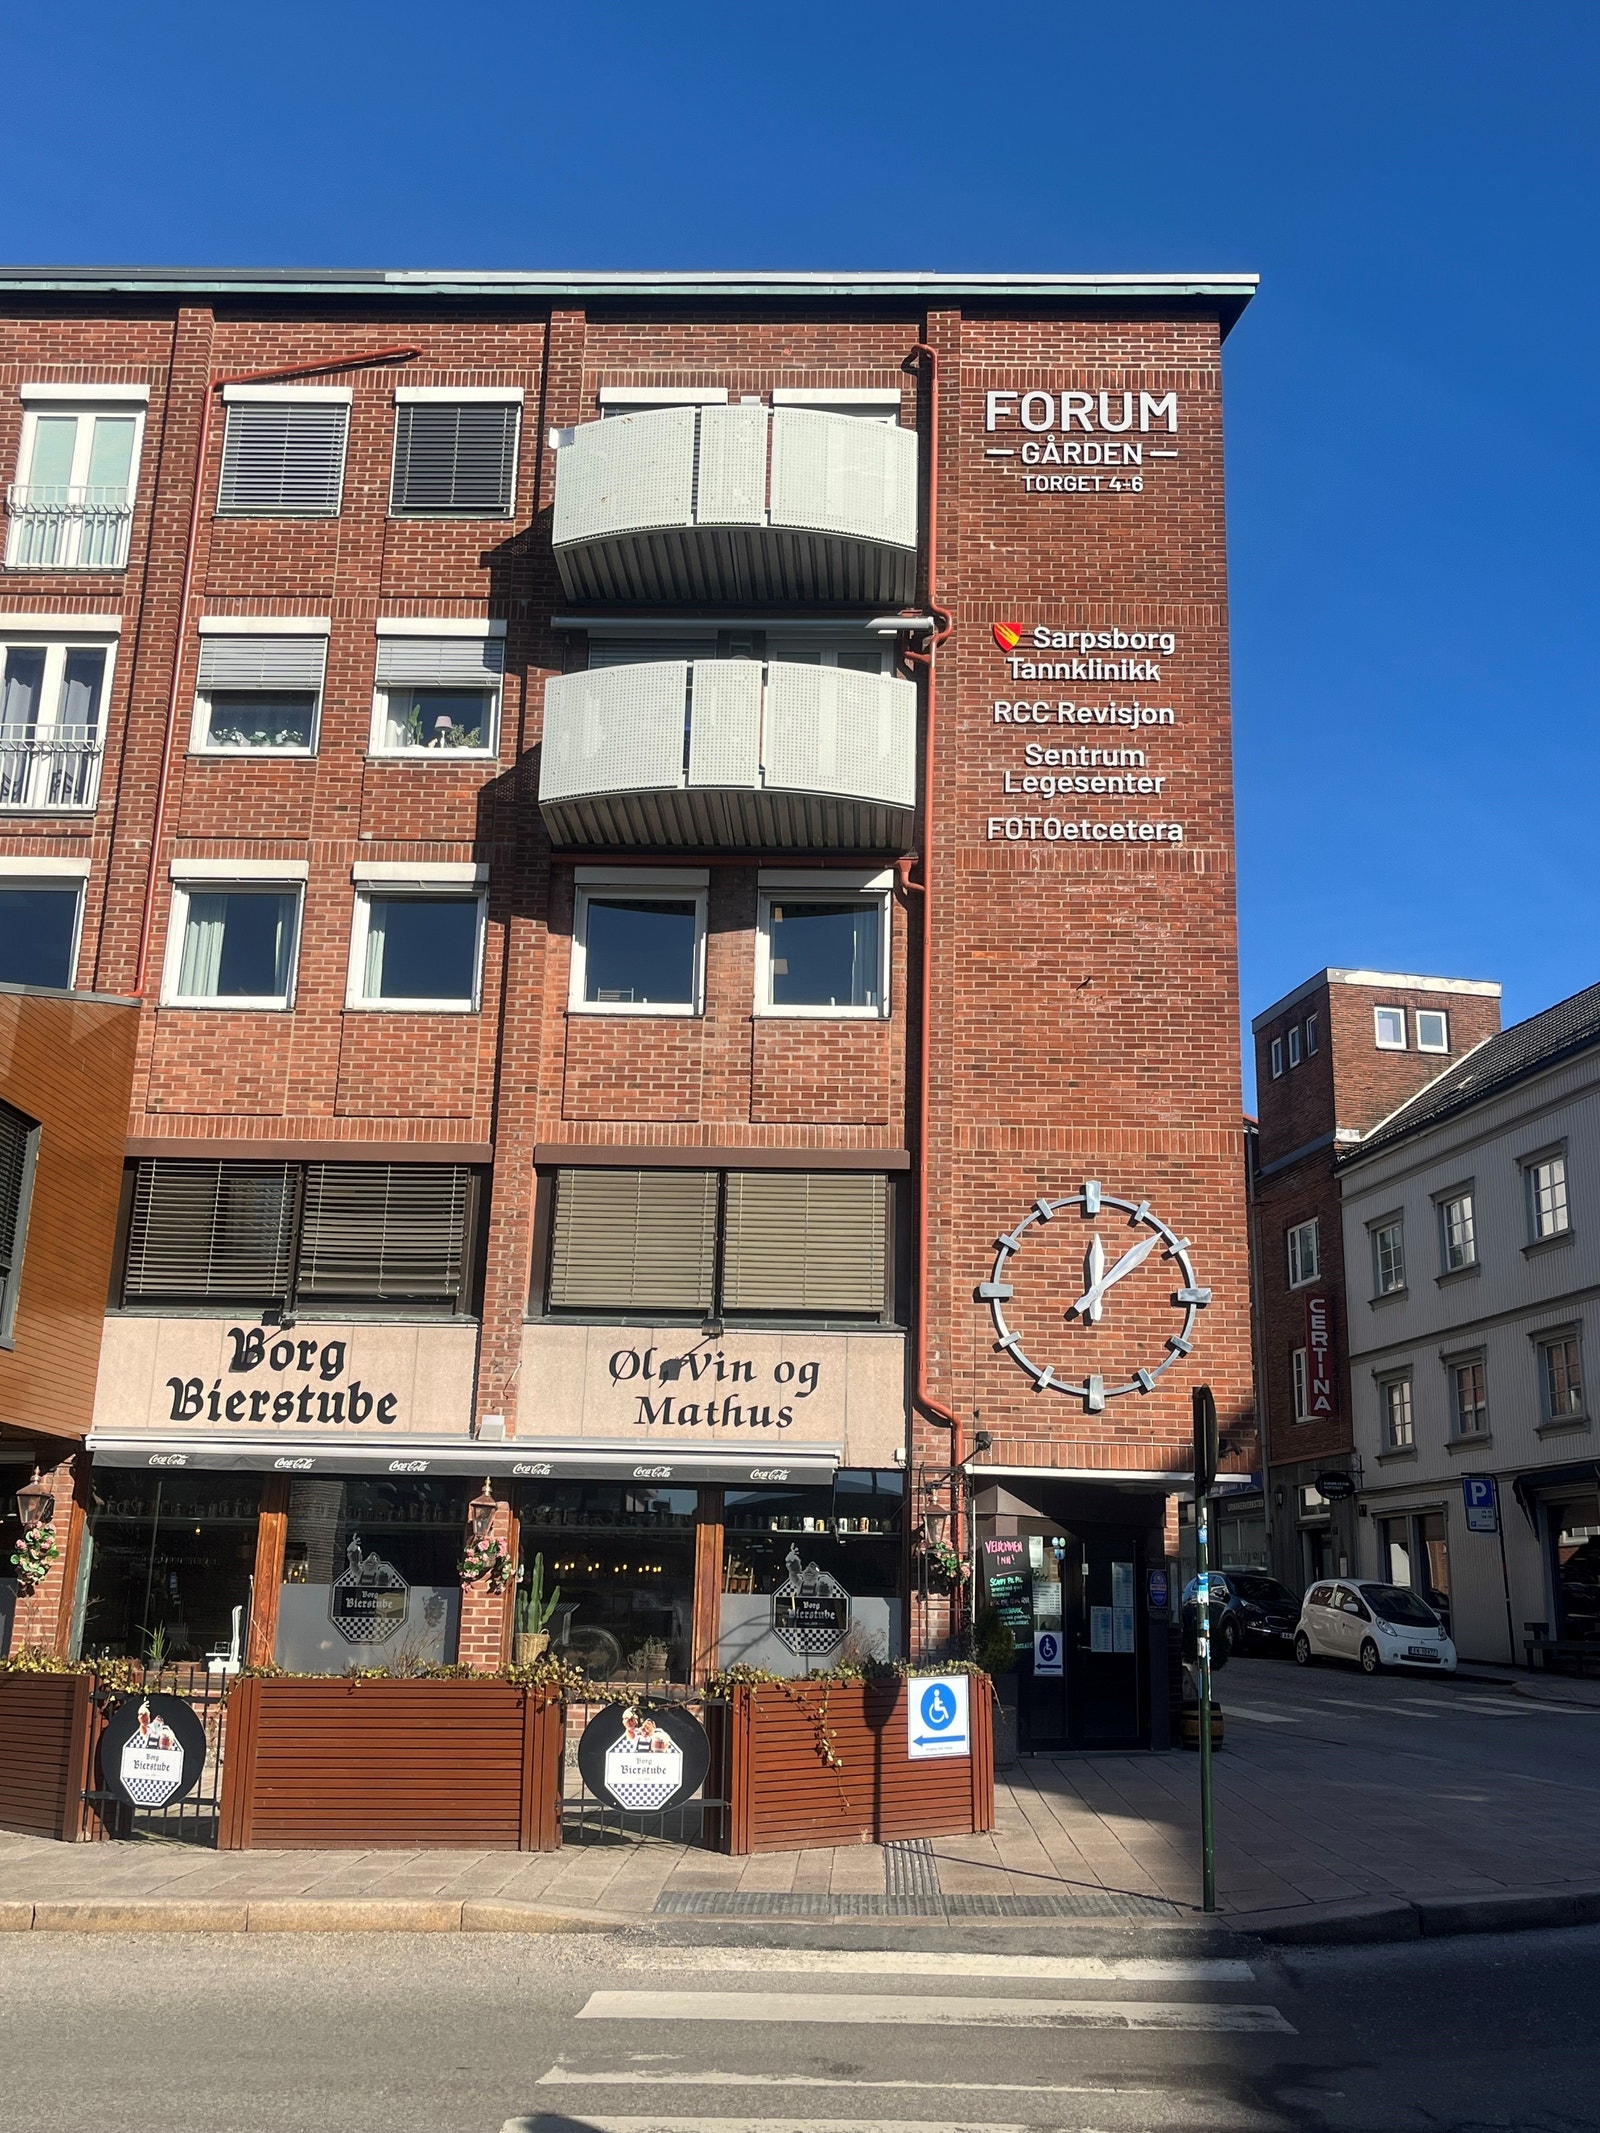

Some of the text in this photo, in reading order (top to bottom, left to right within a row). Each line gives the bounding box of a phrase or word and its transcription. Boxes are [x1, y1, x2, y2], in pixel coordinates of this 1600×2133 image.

[985, 390, 1179, 433] FORUM
[1021, 435, 1143, 467] GÅRDEN
[1021, 474, 1144, 493] TORGET 4-6
[1032, 626, 1176, 656] Sarpsborg
[1006, 656, 1161, 682] Tannklinikk
[993, 701, 1175, 731] RCC Revisjon
[1024, 743, 1145, 768] Sentrum
[1003, 770, 1166, 799] Legesenter
[986, 816, 1184, 842] FOTOetcetera
[227, 1327, 347, 1381] Borg
[1309, 1298, 1332, 1411] CERTINA
[684, 1350, 758, 1382] Vin
[773, 1360, 821, 1398] og
[166, 1376, 398, 1425] Bierstube
[633, 1393, 794, 1429] Mathus
[1471, 1482, 1487, 1505] P
[345, 1597, 393, 1609] Bierstube
[361, 1590, 379, 1600] Borg
[802, 1601, 820, 1610] Borg
[133, 1760, 170, 1772] Bierstube
[146, 1753, 159, 1762] Borg
[620, 1764, 667, 1775] Bierstube
[636, 1757, 652, 1765] Borg
